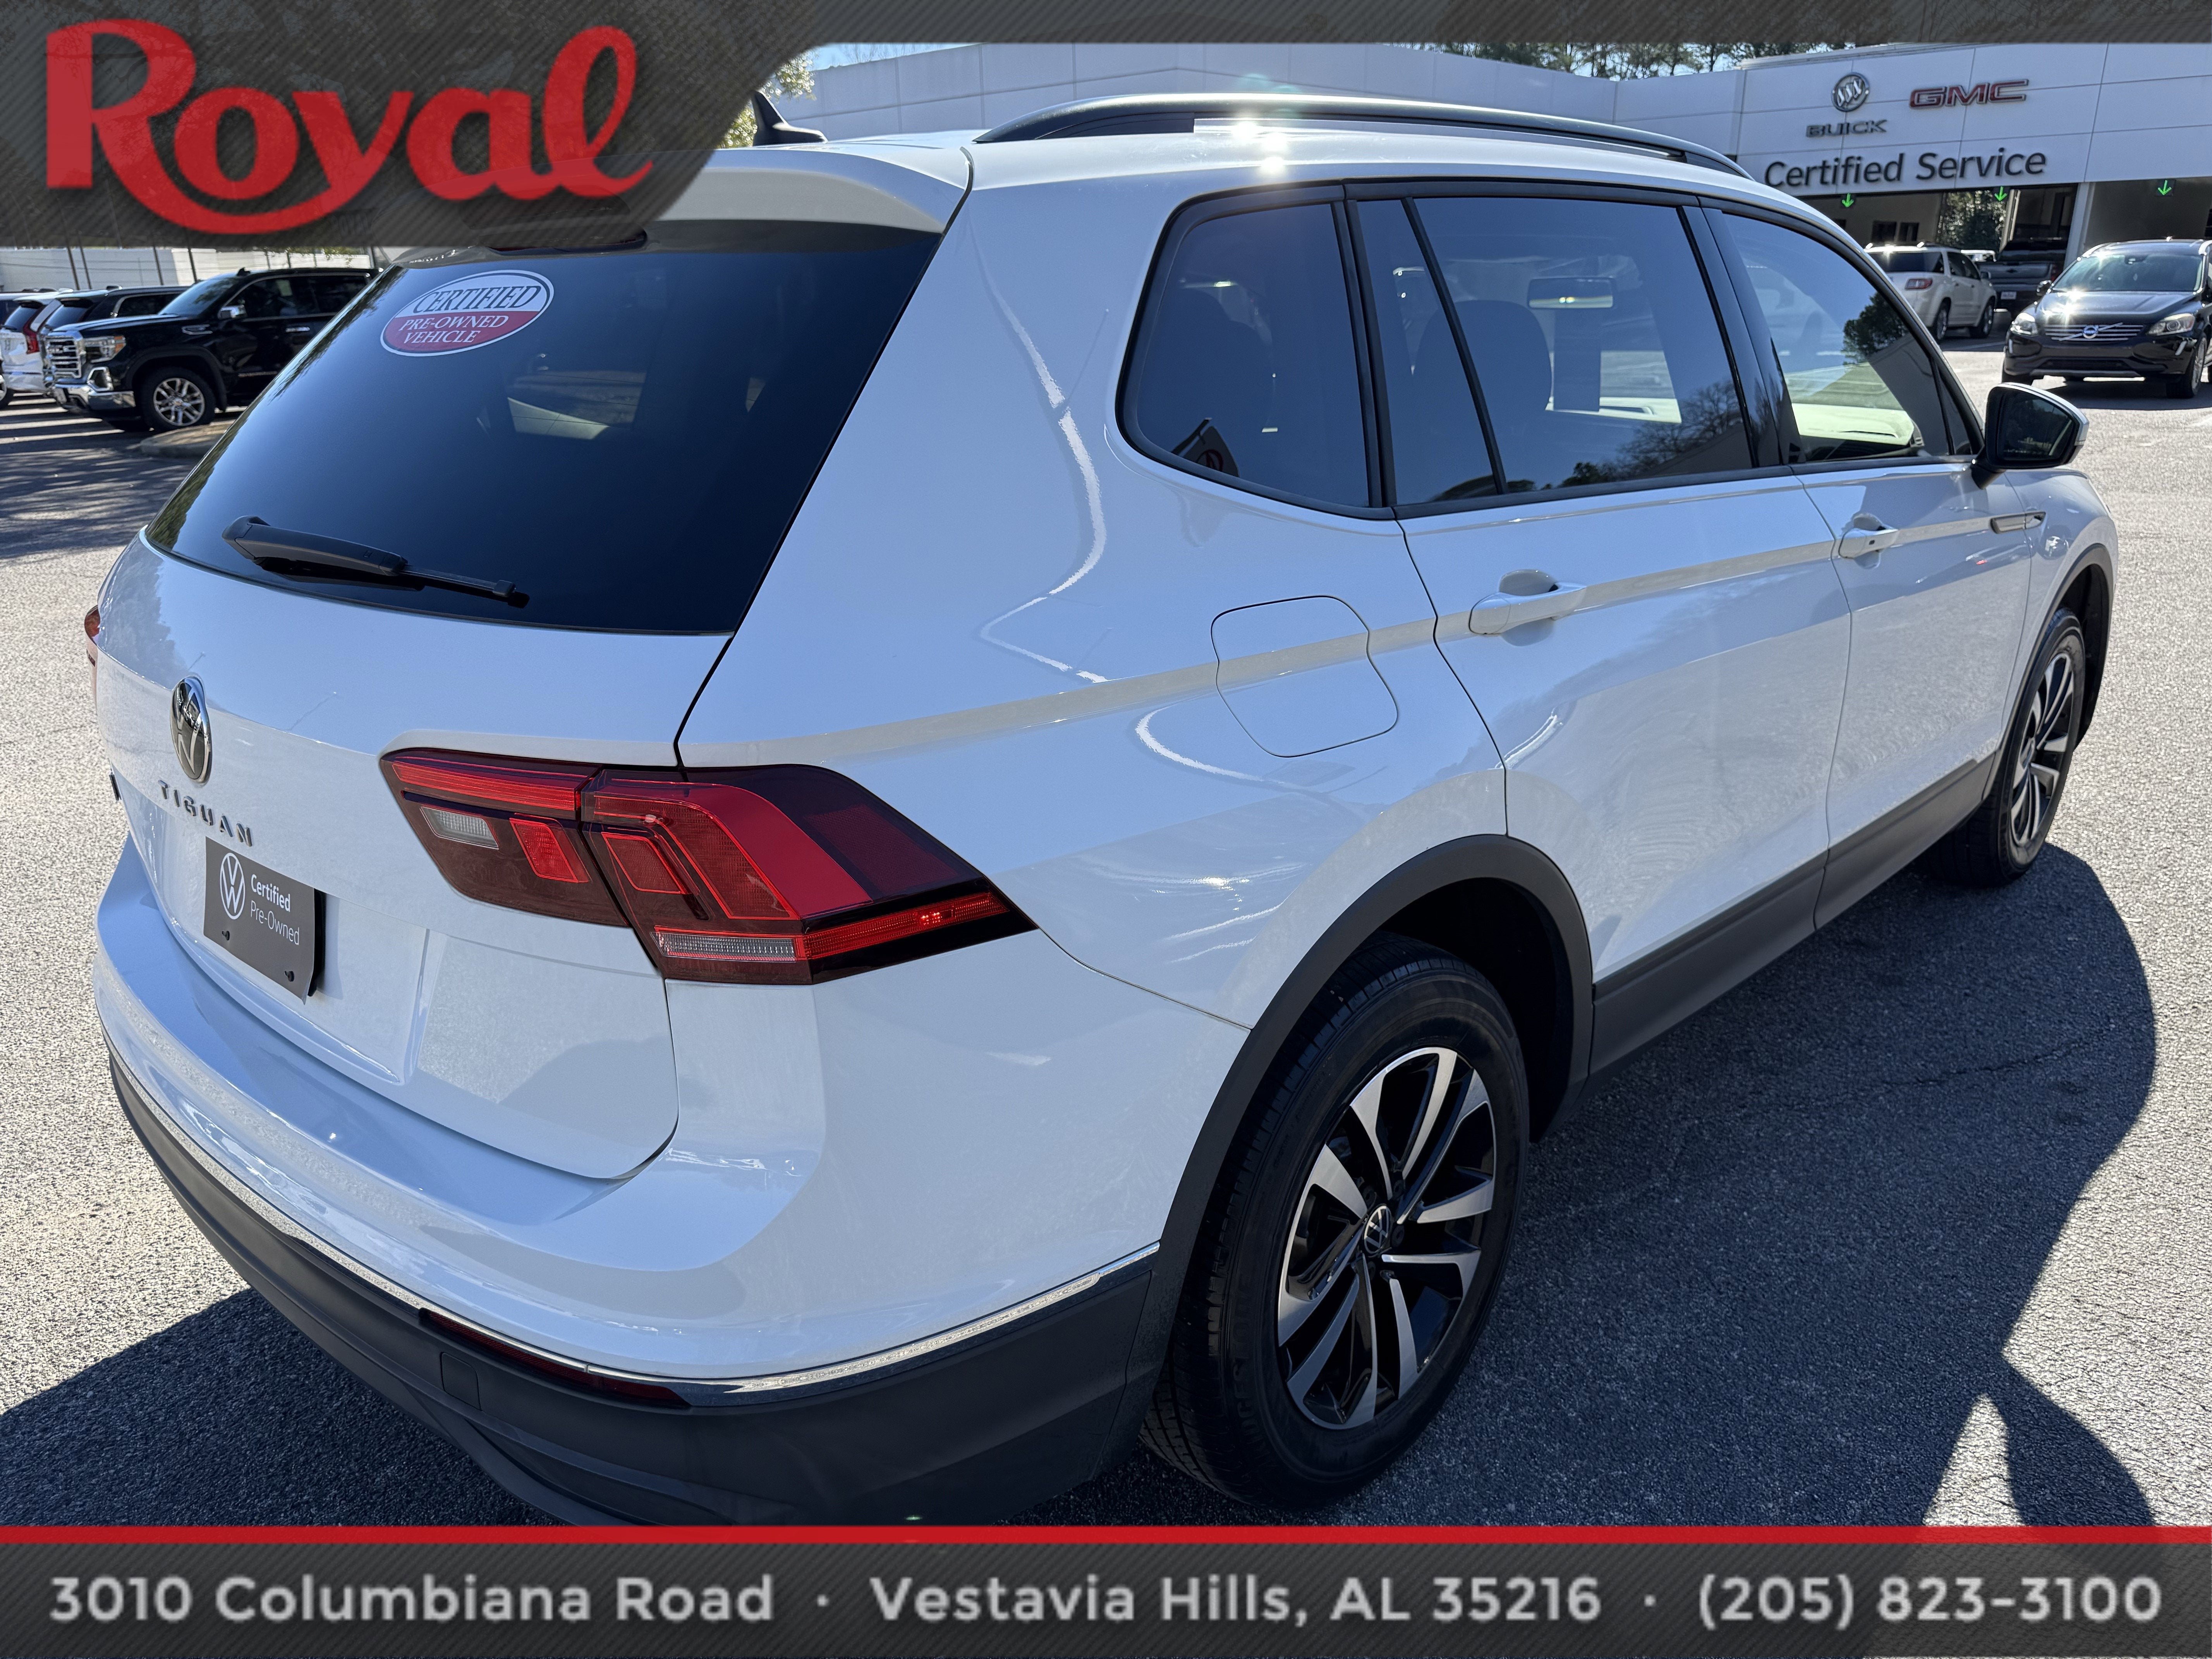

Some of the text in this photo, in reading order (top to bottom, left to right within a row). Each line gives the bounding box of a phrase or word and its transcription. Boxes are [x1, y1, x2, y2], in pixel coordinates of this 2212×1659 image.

[1909, 79, 2029, 110] GMC
[1805, 119, 1887, 137] BUICK
[1764, 147, 2046, 187] Certified Service
[413, 285, 541, 313] CERTIFIED
[398, 315, 509, 331] PRE-OWNED
[403, 330, 481, 344] VEHICLE
[158, 780, 252, 847] TIGUAN
[251, 874, 290, 912] Certified
[251, 900, 300, 945] Pre-Owned
